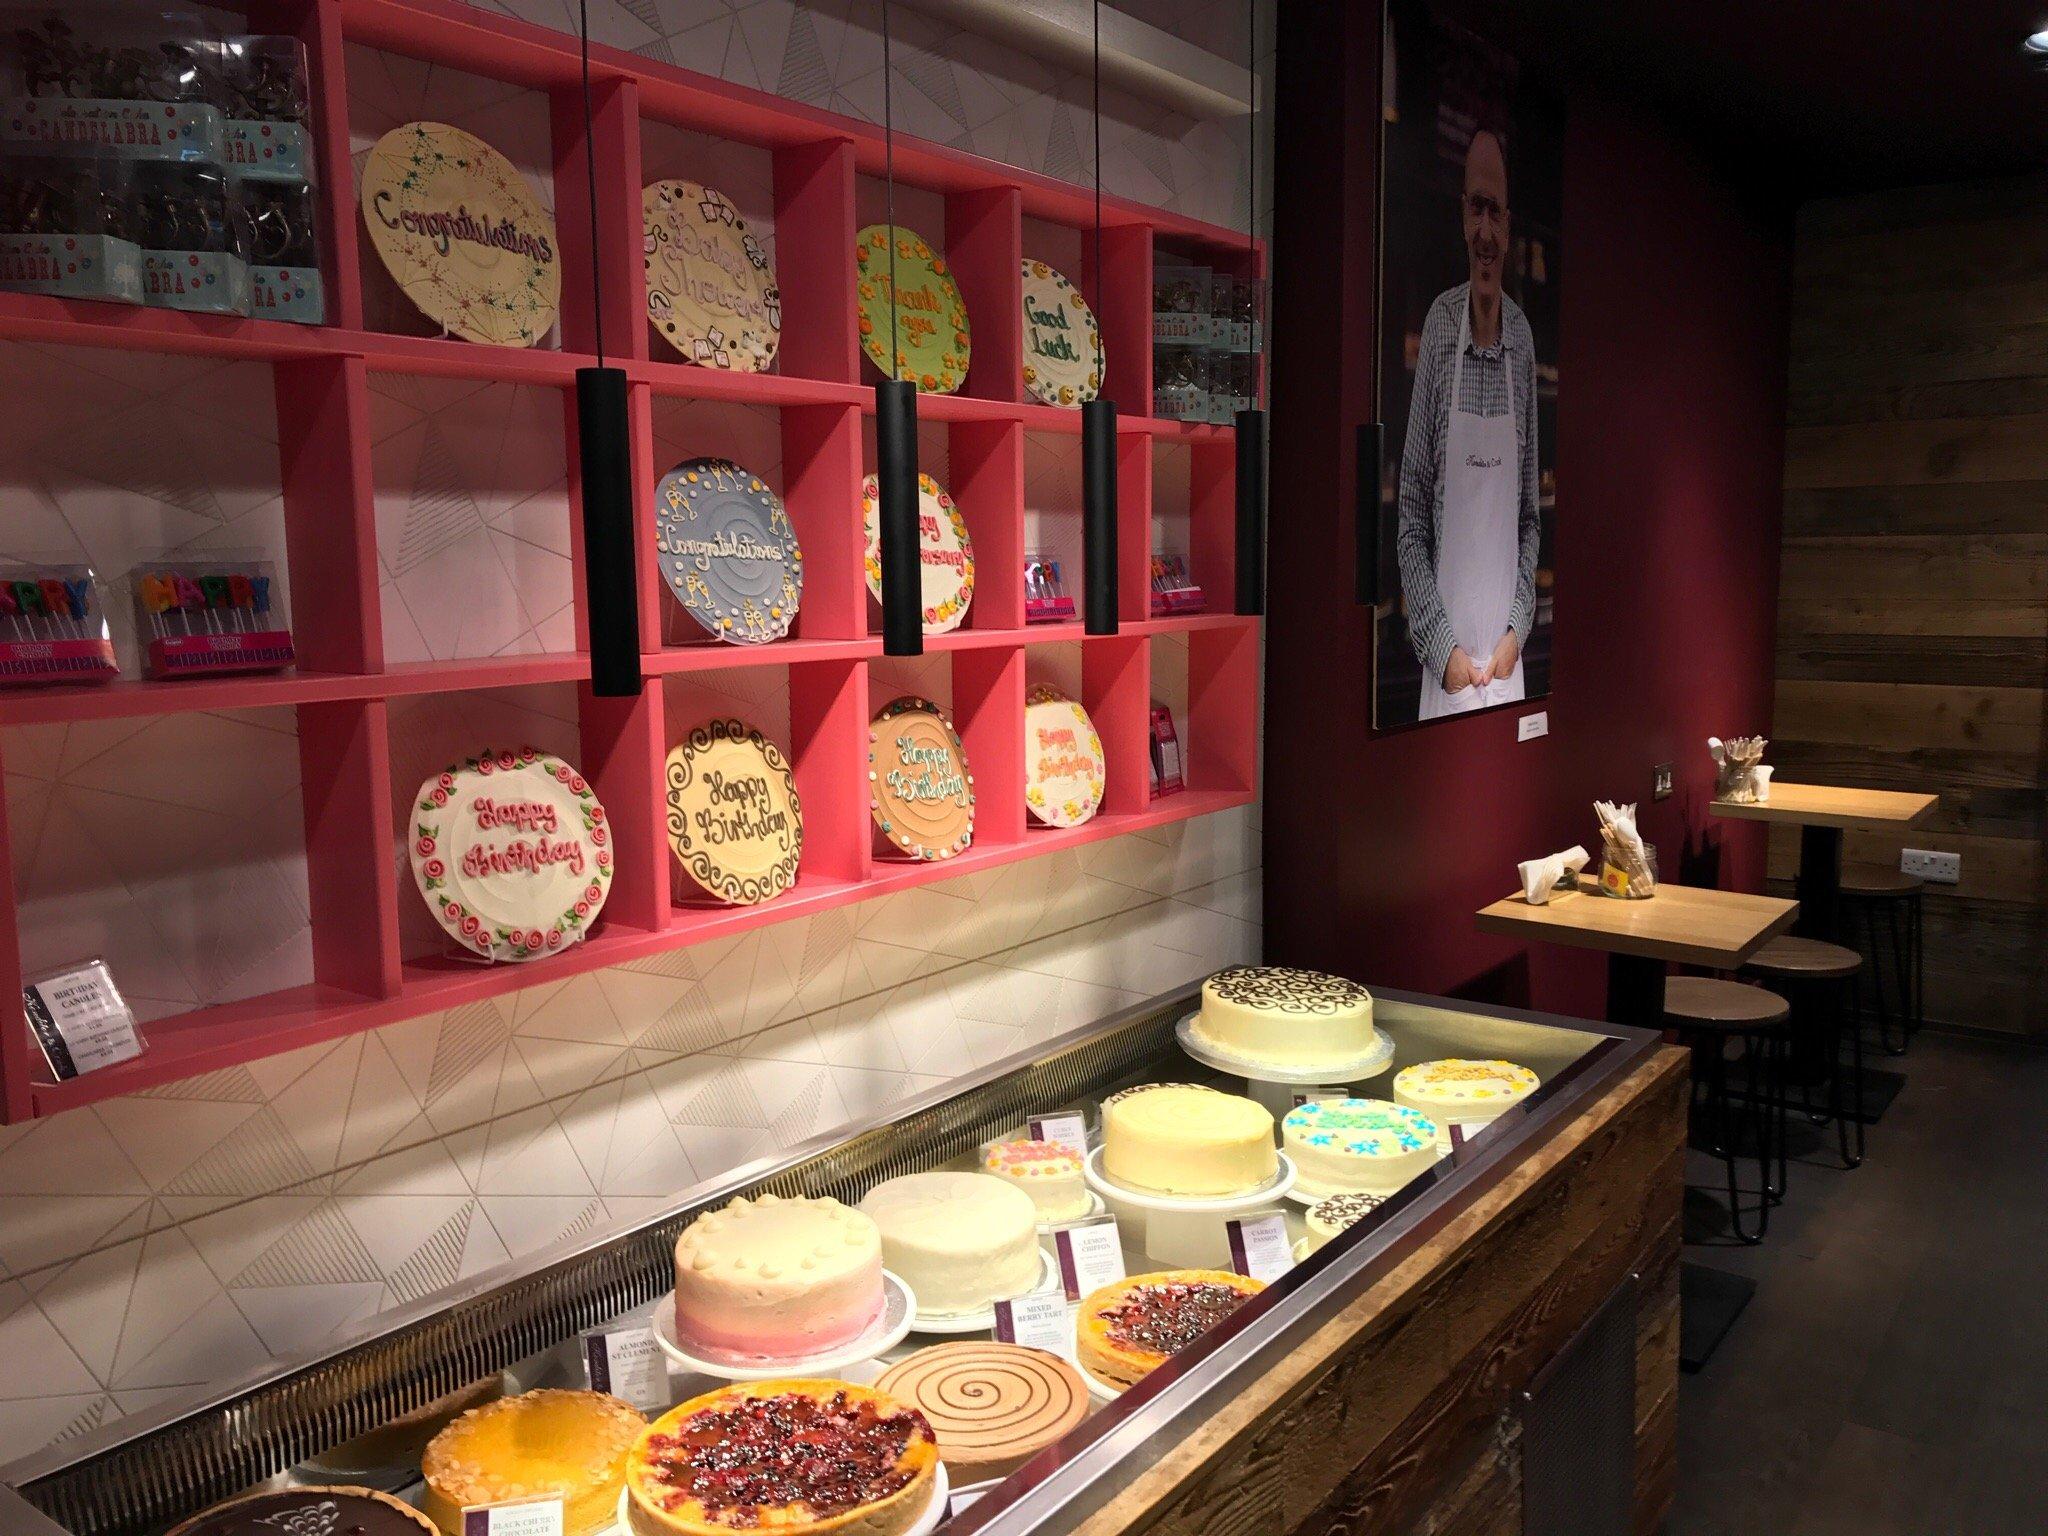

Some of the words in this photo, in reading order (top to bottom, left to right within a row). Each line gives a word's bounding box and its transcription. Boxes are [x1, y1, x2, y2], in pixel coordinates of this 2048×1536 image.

[374, 190, 553, 264] Congratulations
[1024, 295, 1071, 330] Good
[1029, 327, 1080, 363] Luck
[896, 736, 952, 778] Happy
[703, 771, 770, 814] Happy
[887, 769, 966, 808] Birthday
[474, 797, 559, 833] Happy
[696, 807, 790, 851] Birthday
[462, 838, 586, 878] Birthday
[1083, 1237, 1107, 1245] LEMON
[1018, 1313, 1042, 1322] BERRY
[1044, 1311, 1062, 1319] TART
[1027, 1304, 1052, 1313] MIXED
[620, 1340, 655, 1350] ALMOND
[493, 1520, 520, 1531] BLACK
[523, 1515, 556, 1527] CHERRY
